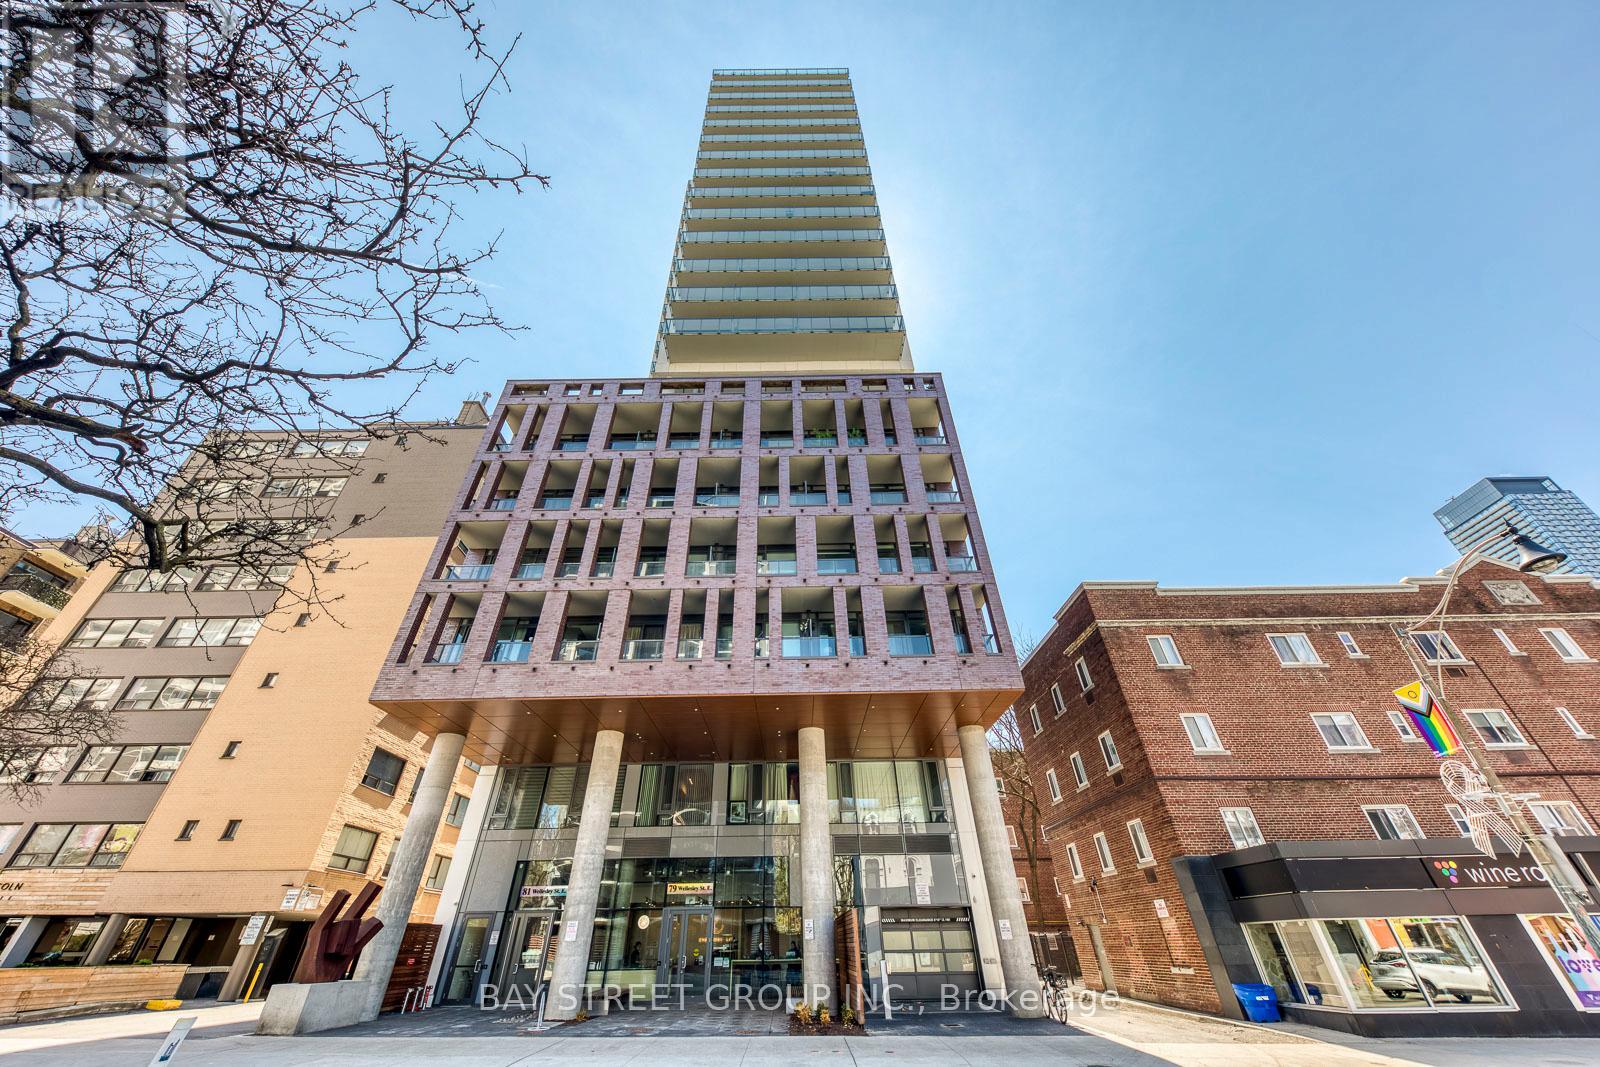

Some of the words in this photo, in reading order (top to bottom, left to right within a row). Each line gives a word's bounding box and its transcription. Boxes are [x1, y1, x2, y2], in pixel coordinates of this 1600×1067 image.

[1464, 861, 1521, 883] wine
[0, 882, 24, 891] OLN
[668, 884, 678, 893] 79
[522, 887, 531, 896] 81
